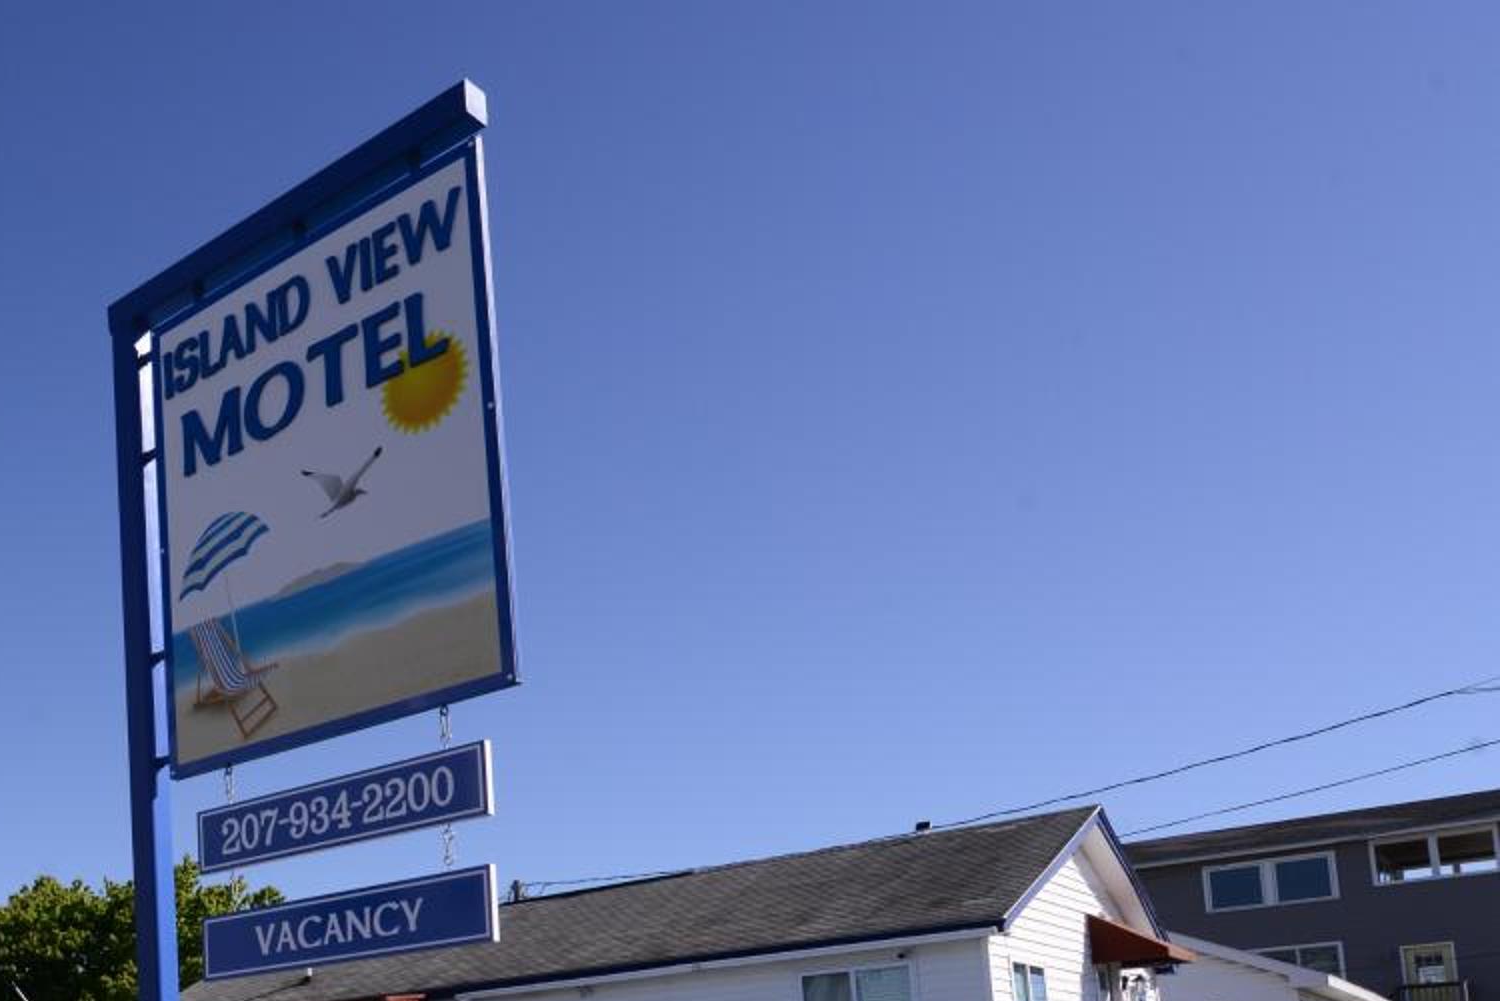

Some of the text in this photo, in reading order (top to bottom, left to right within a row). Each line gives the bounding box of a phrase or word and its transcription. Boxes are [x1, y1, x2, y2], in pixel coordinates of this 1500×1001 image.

[164, 186, 461, 400] ISLAND VIEW
[181, 292, 450, 477] MOTEL
[221, 766, 454, 855] 207-934-2200
[255, 898, 424, 956] VACANCY
